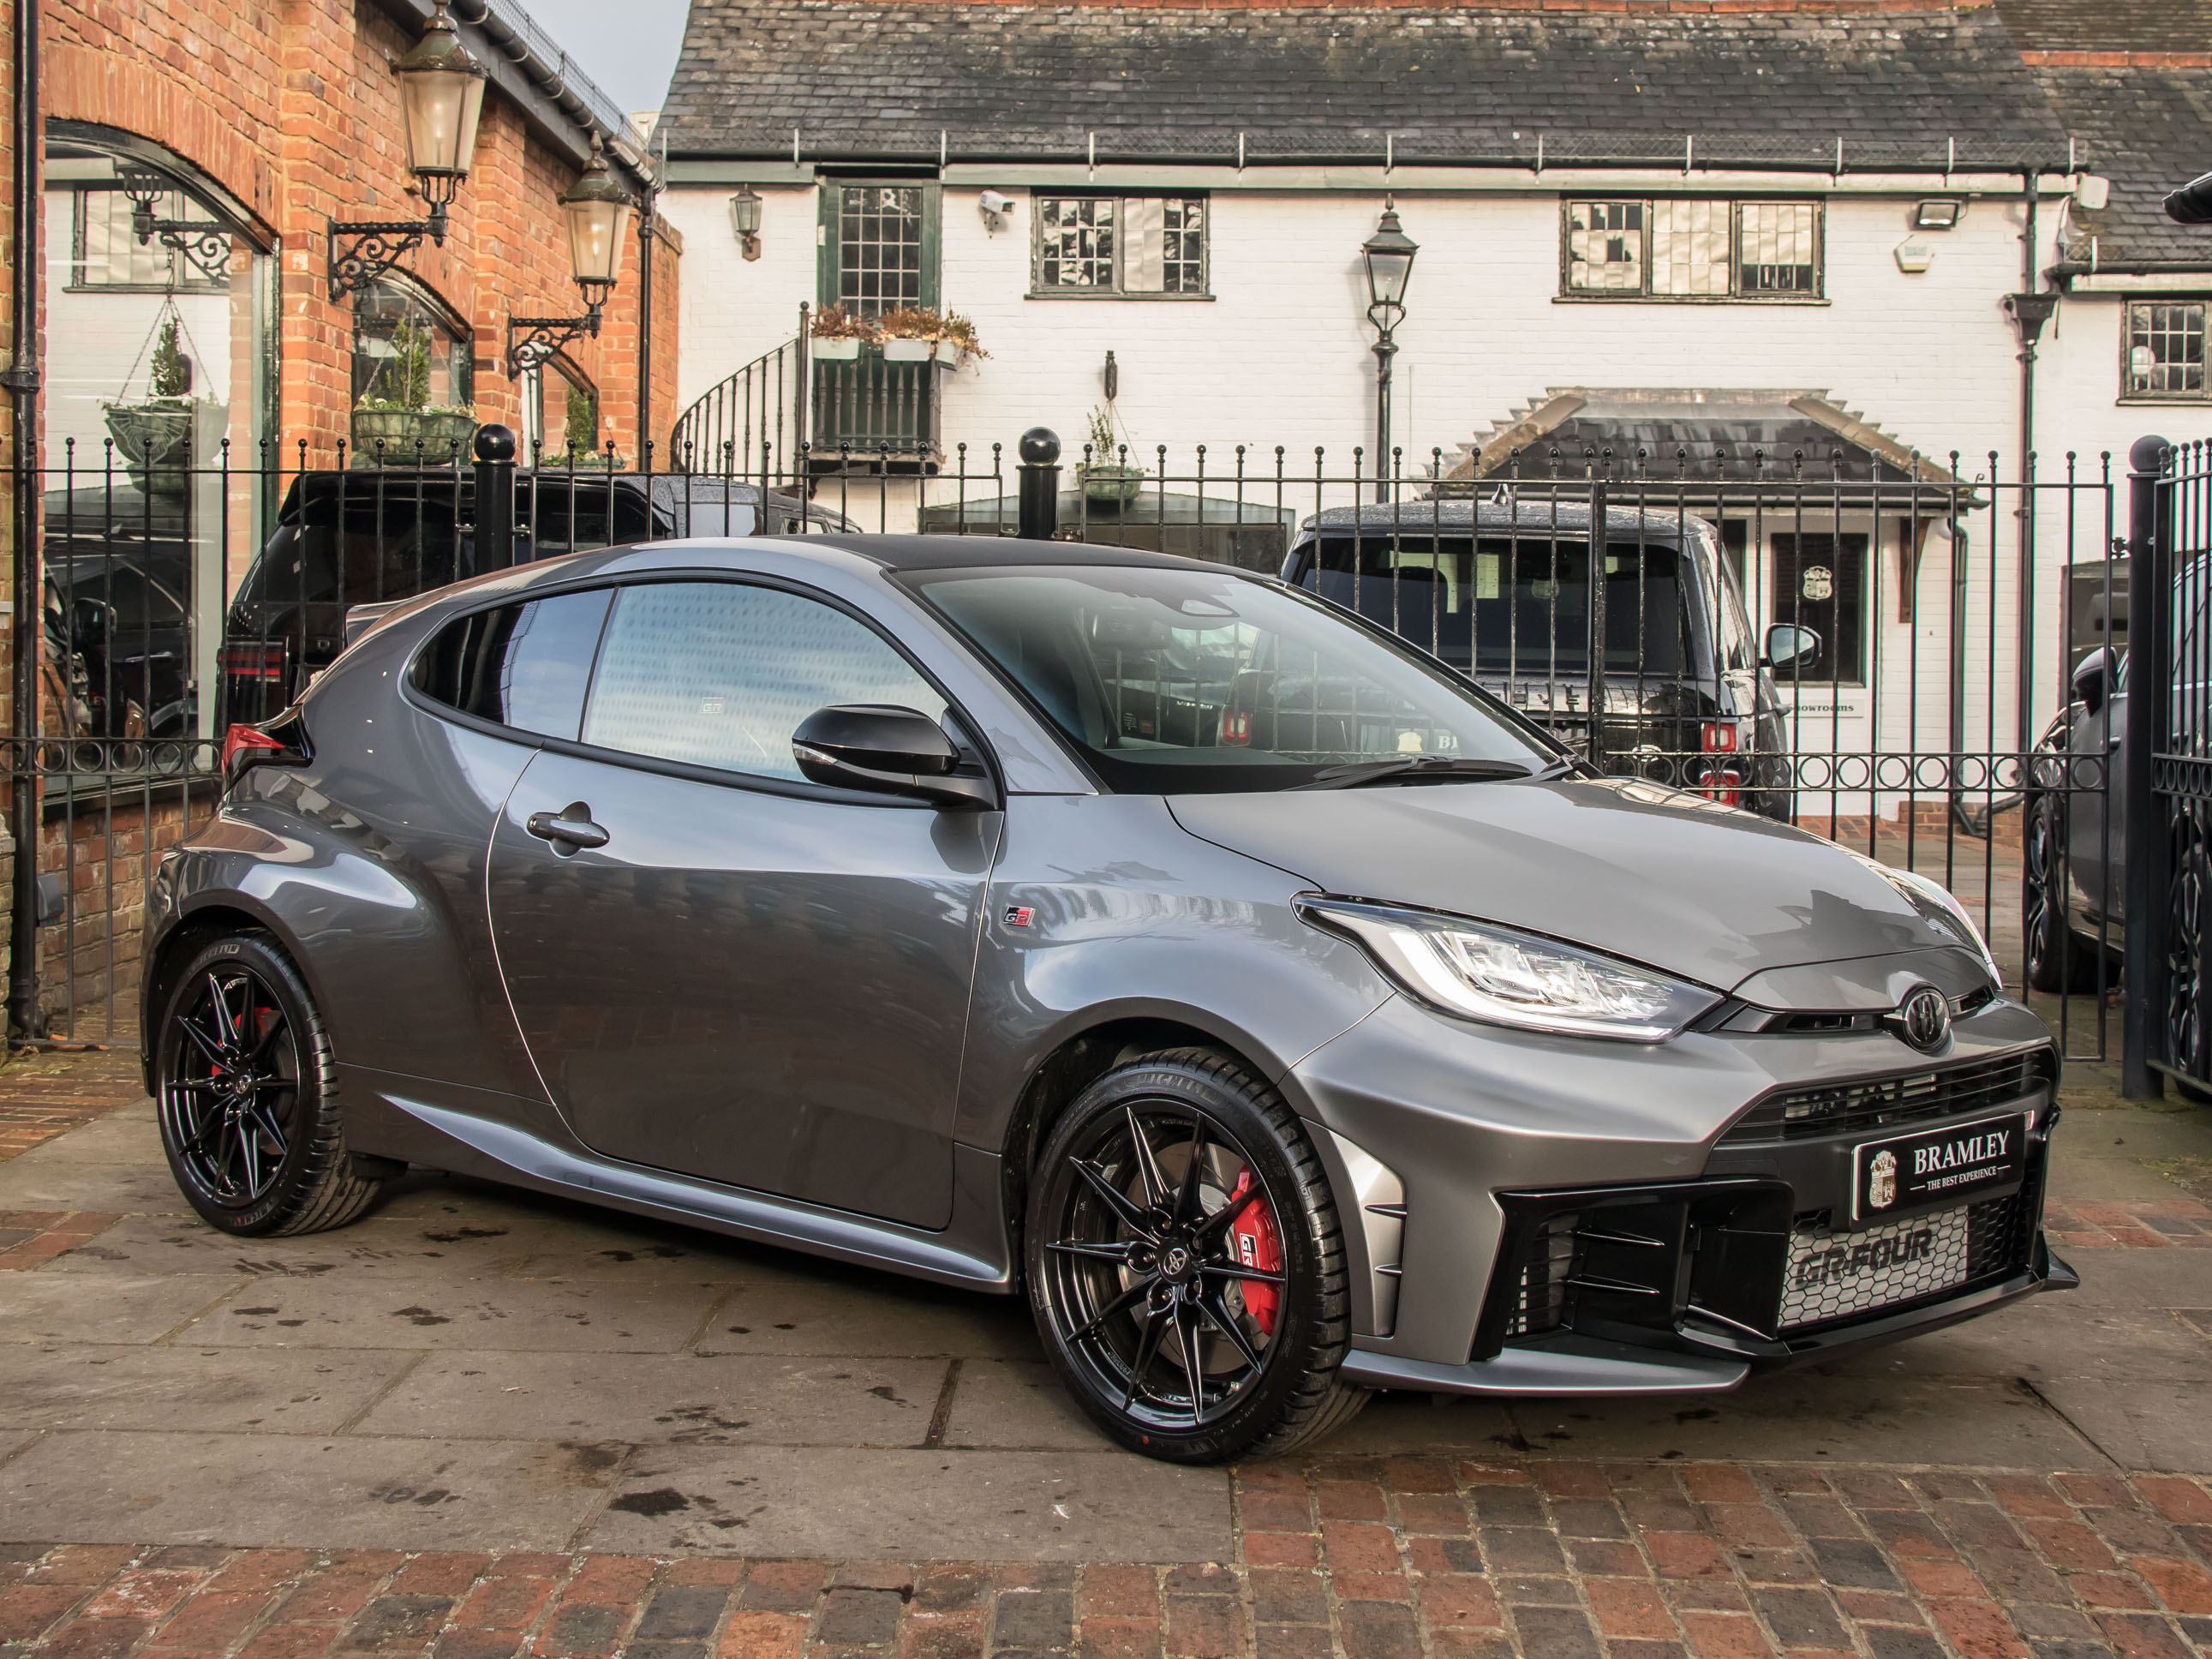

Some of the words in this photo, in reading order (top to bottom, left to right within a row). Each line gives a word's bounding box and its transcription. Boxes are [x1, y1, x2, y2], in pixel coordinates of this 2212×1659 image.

[1005, 913, 1028, 924] GR
[1914, 1129, 2009, 1175] BRAMLEY
[1927, 1179, 1941, 1191] THE
[1941, 1175, 1958, 1188] BEST
[1958, 1165, 1997, 1184] EXPERIENCE
